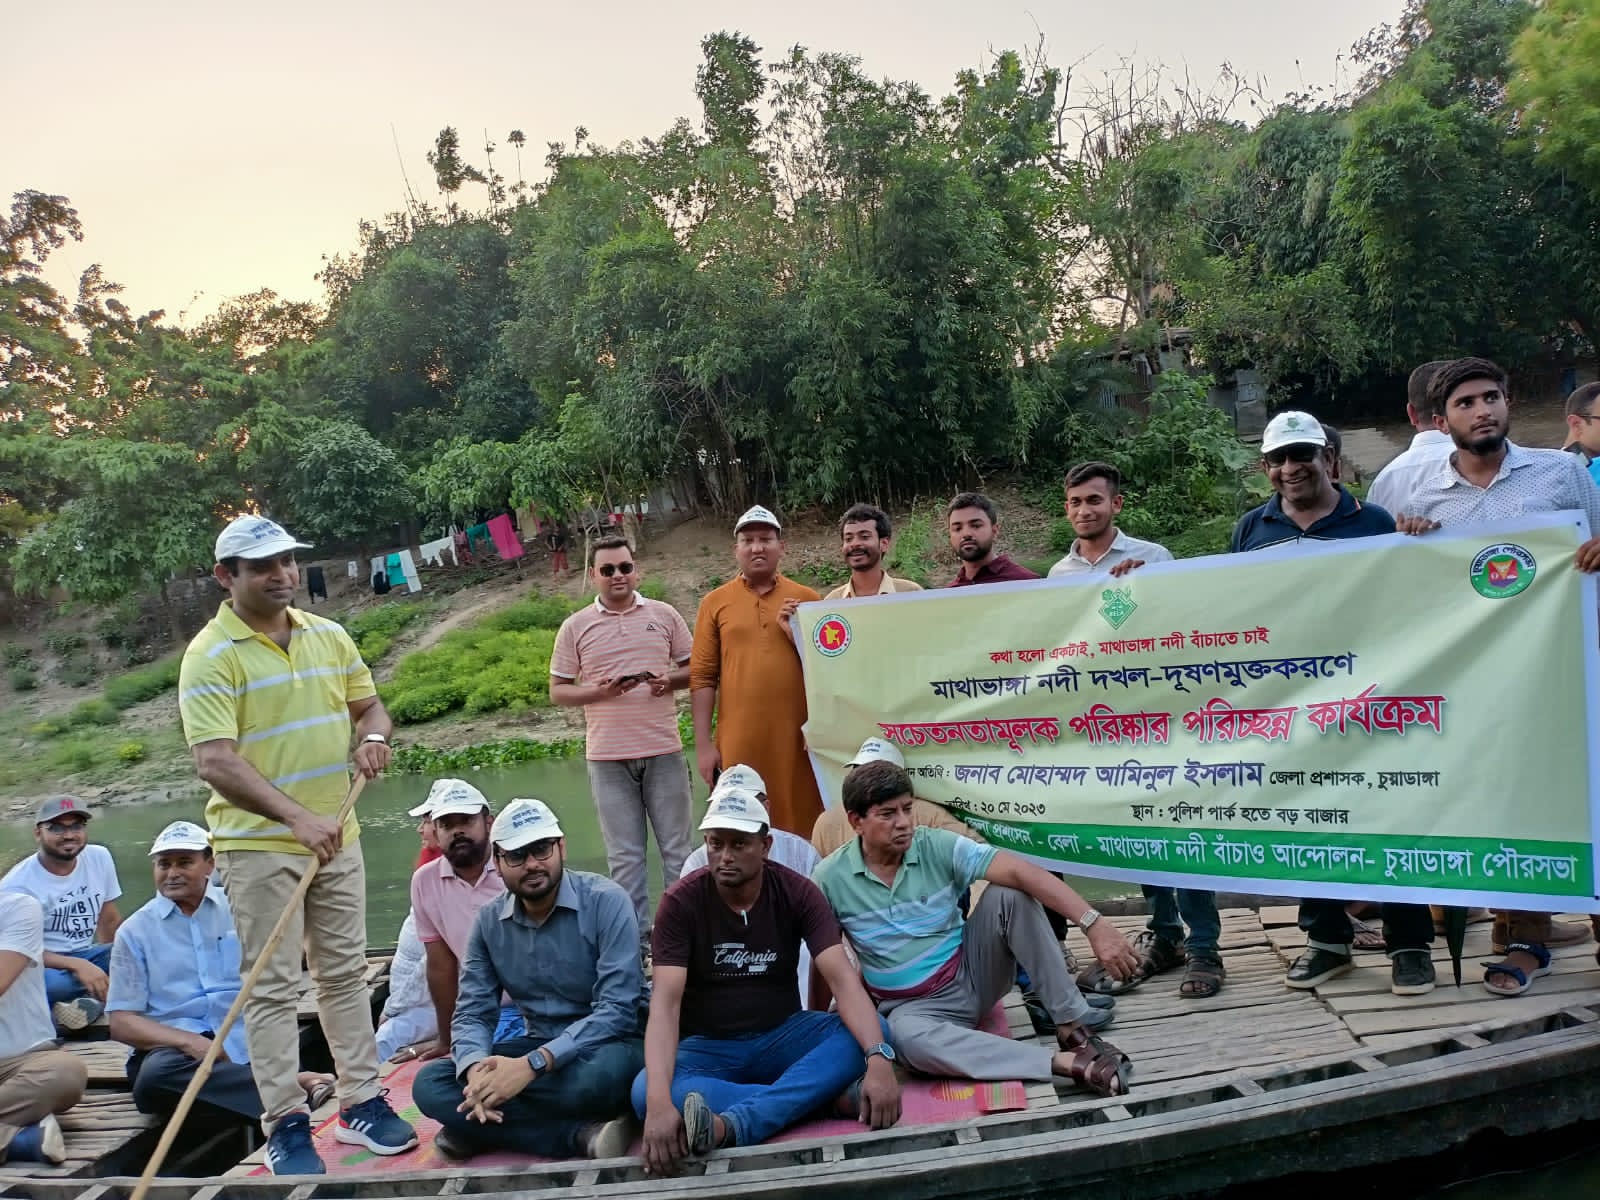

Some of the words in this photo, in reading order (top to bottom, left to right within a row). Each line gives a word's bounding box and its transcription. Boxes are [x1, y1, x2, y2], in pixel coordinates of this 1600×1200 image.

[989, 651, 1012, 664] কথা
[1016, 649, 1045, 663] হলো
[1049, 641, 1095, 659] একটাই,
[1100, 637, 1155, 654] মাথাভাঙ্গা
[1159, 631, 1186, 650] নদী
[1189, 629, 1238, 648] বাঁচাতে
[1242, 626, 1270, 644] চাই
[930, 673, 1031, 699] মাথাভাঙ্গা
[1037, 664, 1082, 693] নদী
[877, 717, 1061, 755] সচেতনতামূলক
[1068, 703, 1173, 745] পরিষ্কার
[1182, 697, 1298, 742] পরিচ্ছন্ন
[1305, 683, 1447, 736] কার্যক্রম
[954, 764, 1004, 785] জনাব
[1007, 762, 1090, 786] মোহাম্মদ
[1095, 759, 1179, 792] আমিনুল
[1184, 758, 1265, 788] ইসলাম
[1269, 770, 1305, 786] জেলা
[1377, 770, 1440, 791] চুয়াডাঙ্গা
[980, 801, 995, 814] ২০
[998, 800, 1011, 814] মে
[1013, 801, 1046, 816] ২০২৩
[1130, 804, 1155, 820] স্থান
[1167, 801, 1203, 823] পুলিশ
[1207, 802, 1236, 821] পার্ক
[1240, 806, 1272, 822] হতে
[1276, 807, 1299, 825] বড়
[1304, 807, 1350, 825] বাজার
[1047, 832, 1079, 856] বেলা
[1096, 833, 1169, 862] মাথাভাঙ্গা
[1175, 831, 1206, 864] নদী
[1212, 833, 1265, 866] বাঁচাও
[1383, 846, 1475, 880] চুয়াডাঙ্গা
[1482, 843, 1578, 883] পৌরসভা
[713, 948, 778, 968] California
